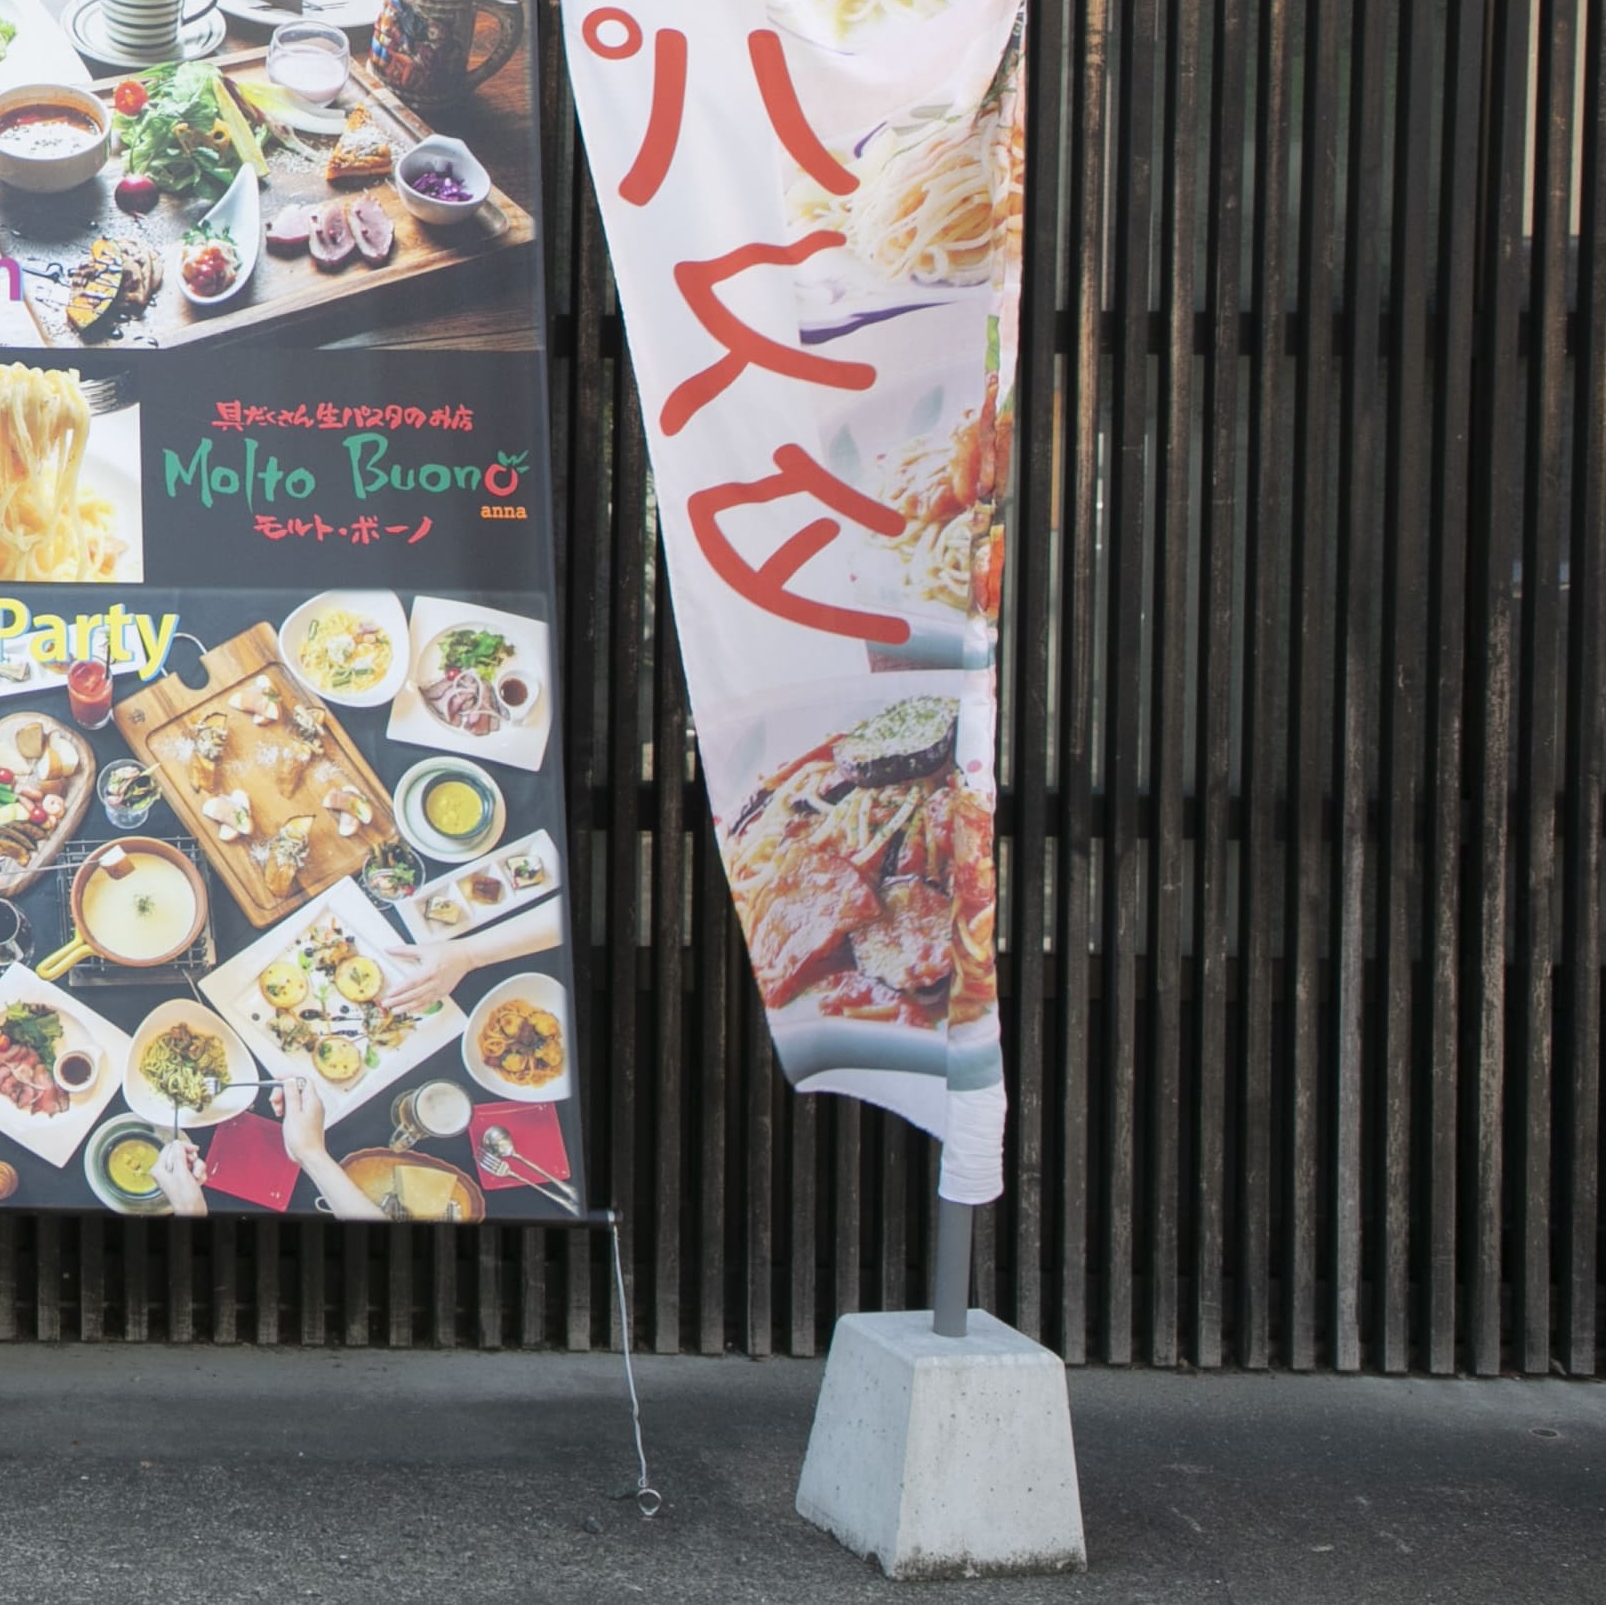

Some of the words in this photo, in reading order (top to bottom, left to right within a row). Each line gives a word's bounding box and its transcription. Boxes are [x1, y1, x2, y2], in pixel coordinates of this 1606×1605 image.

[163, 437, 316, 513] Molto
[343, 432, 530, 500] Buono
[480, 504, 528, 521] anna
[253, 513, 433, 544] モルト・ボーノ
